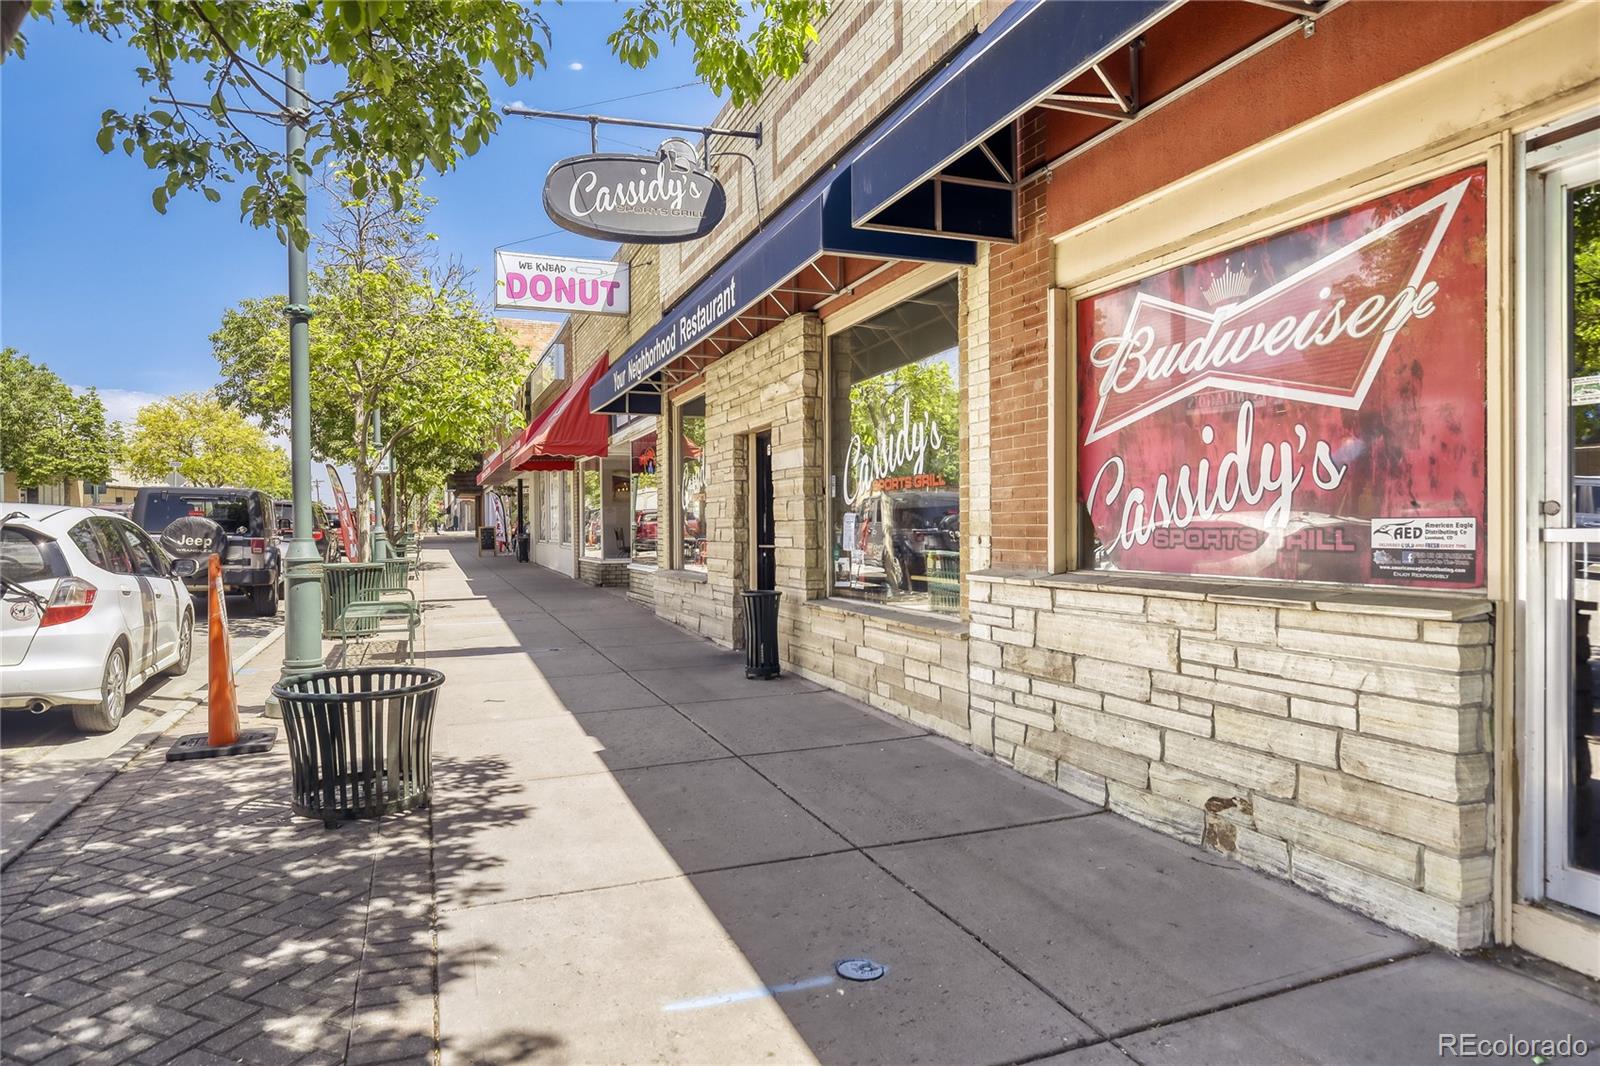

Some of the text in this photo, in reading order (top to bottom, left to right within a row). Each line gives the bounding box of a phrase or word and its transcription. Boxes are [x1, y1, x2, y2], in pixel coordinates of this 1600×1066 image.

[569, 161, 702, 217] Cassidy's
[616, 205, 706, 219] SPORTS GRILL
[518, 260, 567, 274] WE KNEAD
[505, 271, 621, 307] DONUT
[613, 275, 737, 392] Your Neighborhood Restaurant
[1089, 279, 1440, 399] Budweiser
[843, 396, 943, 506] Cassidy's
[872, 472, 946, 492] SPORTS GRILL
[1086, 400, 1347, 554] Cassidy's
[177, 534, 213, 549] Jeep
[1153, 527, 1356, 552] SPORTS RILL
[1394, 526, 1423, 540] AED
